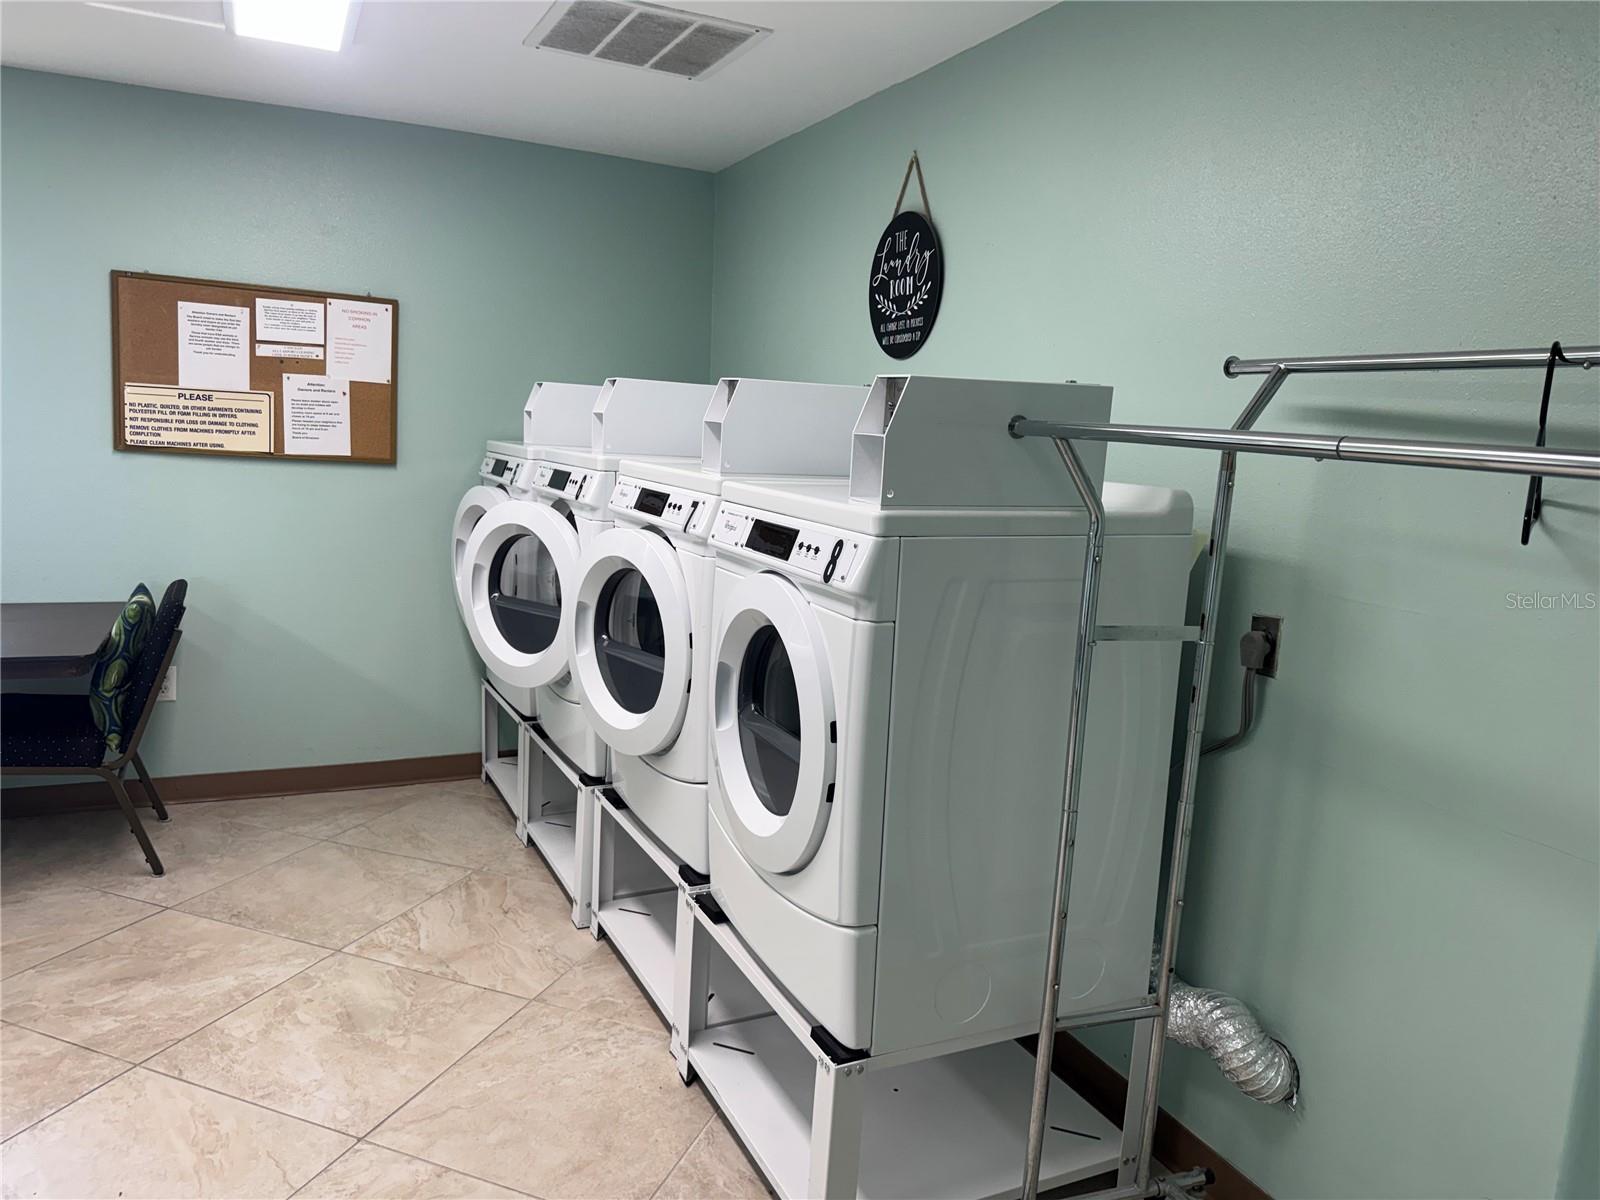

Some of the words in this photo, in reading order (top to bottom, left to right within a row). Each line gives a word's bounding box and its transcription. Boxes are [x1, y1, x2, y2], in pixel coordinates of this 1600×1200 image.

[895, 230, 909, 253] THE
[872, 232, 935, 287] Laundry
[889, 275, 914, 300] ROOM
[177, 392, 214, 402] PLEASE
[683, 500, 699, 534] 7
[823, 539, 844, 584] 8
